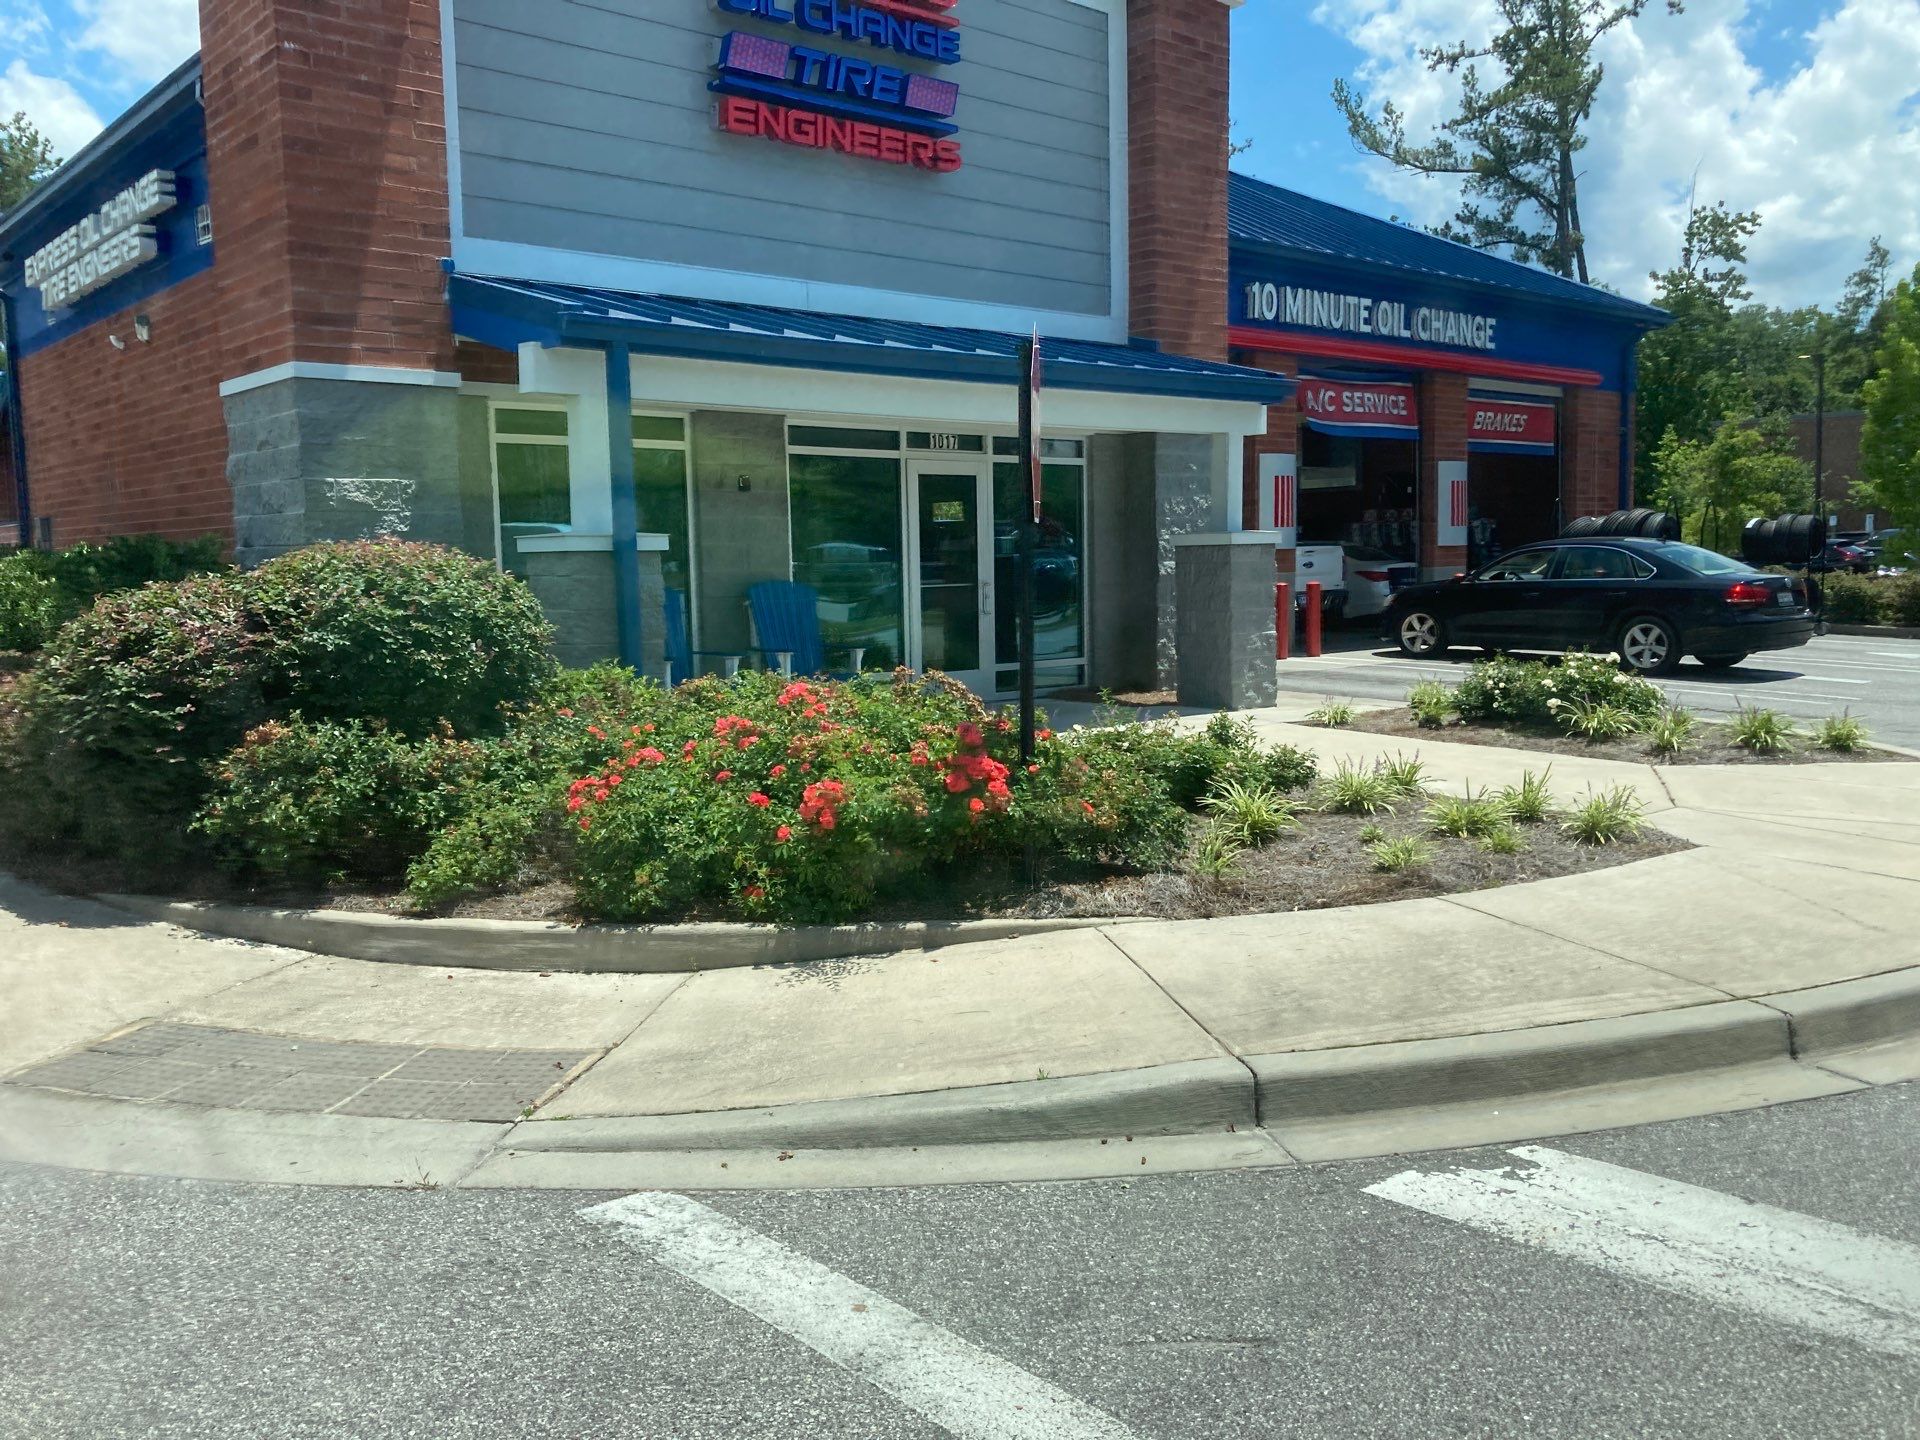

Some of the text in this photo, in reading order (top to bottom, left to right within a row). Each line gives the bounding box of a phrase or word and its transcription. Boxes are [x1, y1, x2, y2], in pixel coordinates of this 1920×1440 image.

[795, 0, 960, 64] CHANGE
[793, 46, 906, 104] TIRE
[722, 96, 961, 172] ENGINEERS
[1246, 281, 1497, 349] 10 MINUTE OIL CHANGE
[1306, 388, 1408, 416] A/C SERVICE
[1473, 410, 1528, 433] BRAKES
[931, 433, 957, 450] 1017
